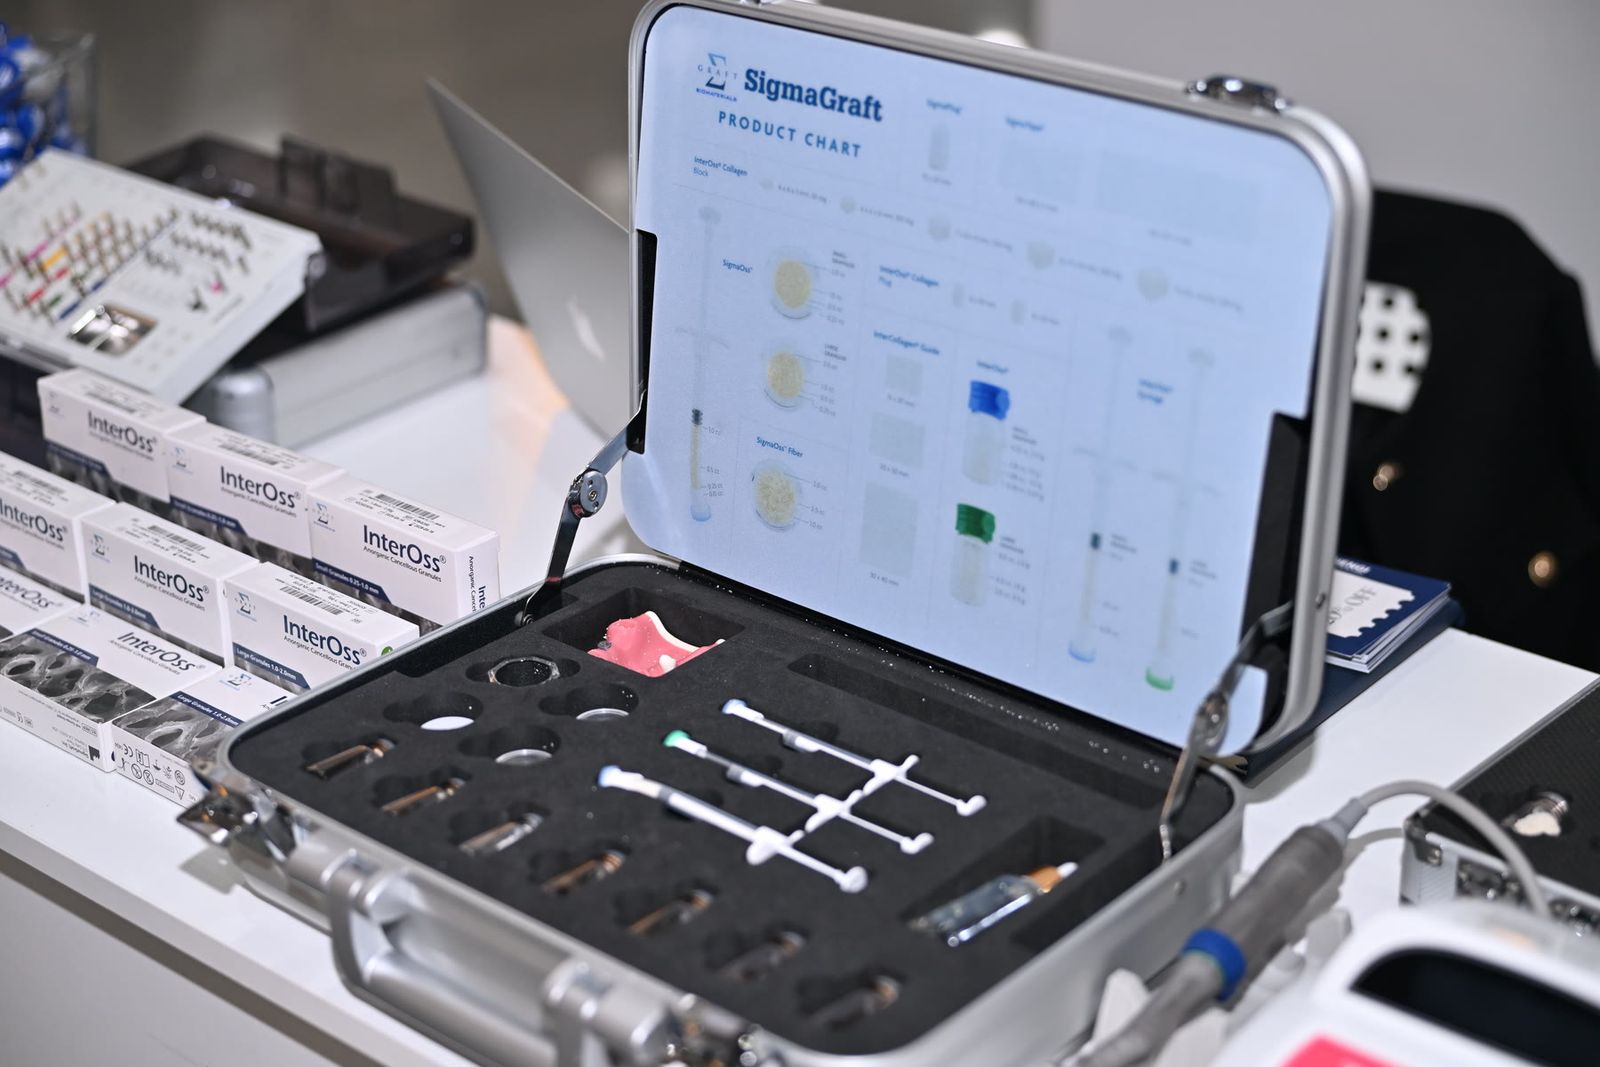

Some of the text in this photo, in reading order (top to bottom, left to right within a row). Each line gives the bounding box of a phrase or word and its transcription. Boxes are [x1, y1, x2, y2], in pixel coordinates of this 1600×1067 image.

[744, 68, 882, 122] SigmaGraft
[718, 110, 861, 158] PRODUCT CHART
[722, 163, 748, 177] Collagen
[363, 545, 442, 583] Anorganic Cancellous Granules
[478, 585, 486, 609] Inte
[236, 647, 250, 659] Large
[250, 653, 271, 669] Granules
[283, 635, 310, 652] Anorganic
[310, 647, 338, 665] Cancellous
[177, 694, 191, 705] Large
